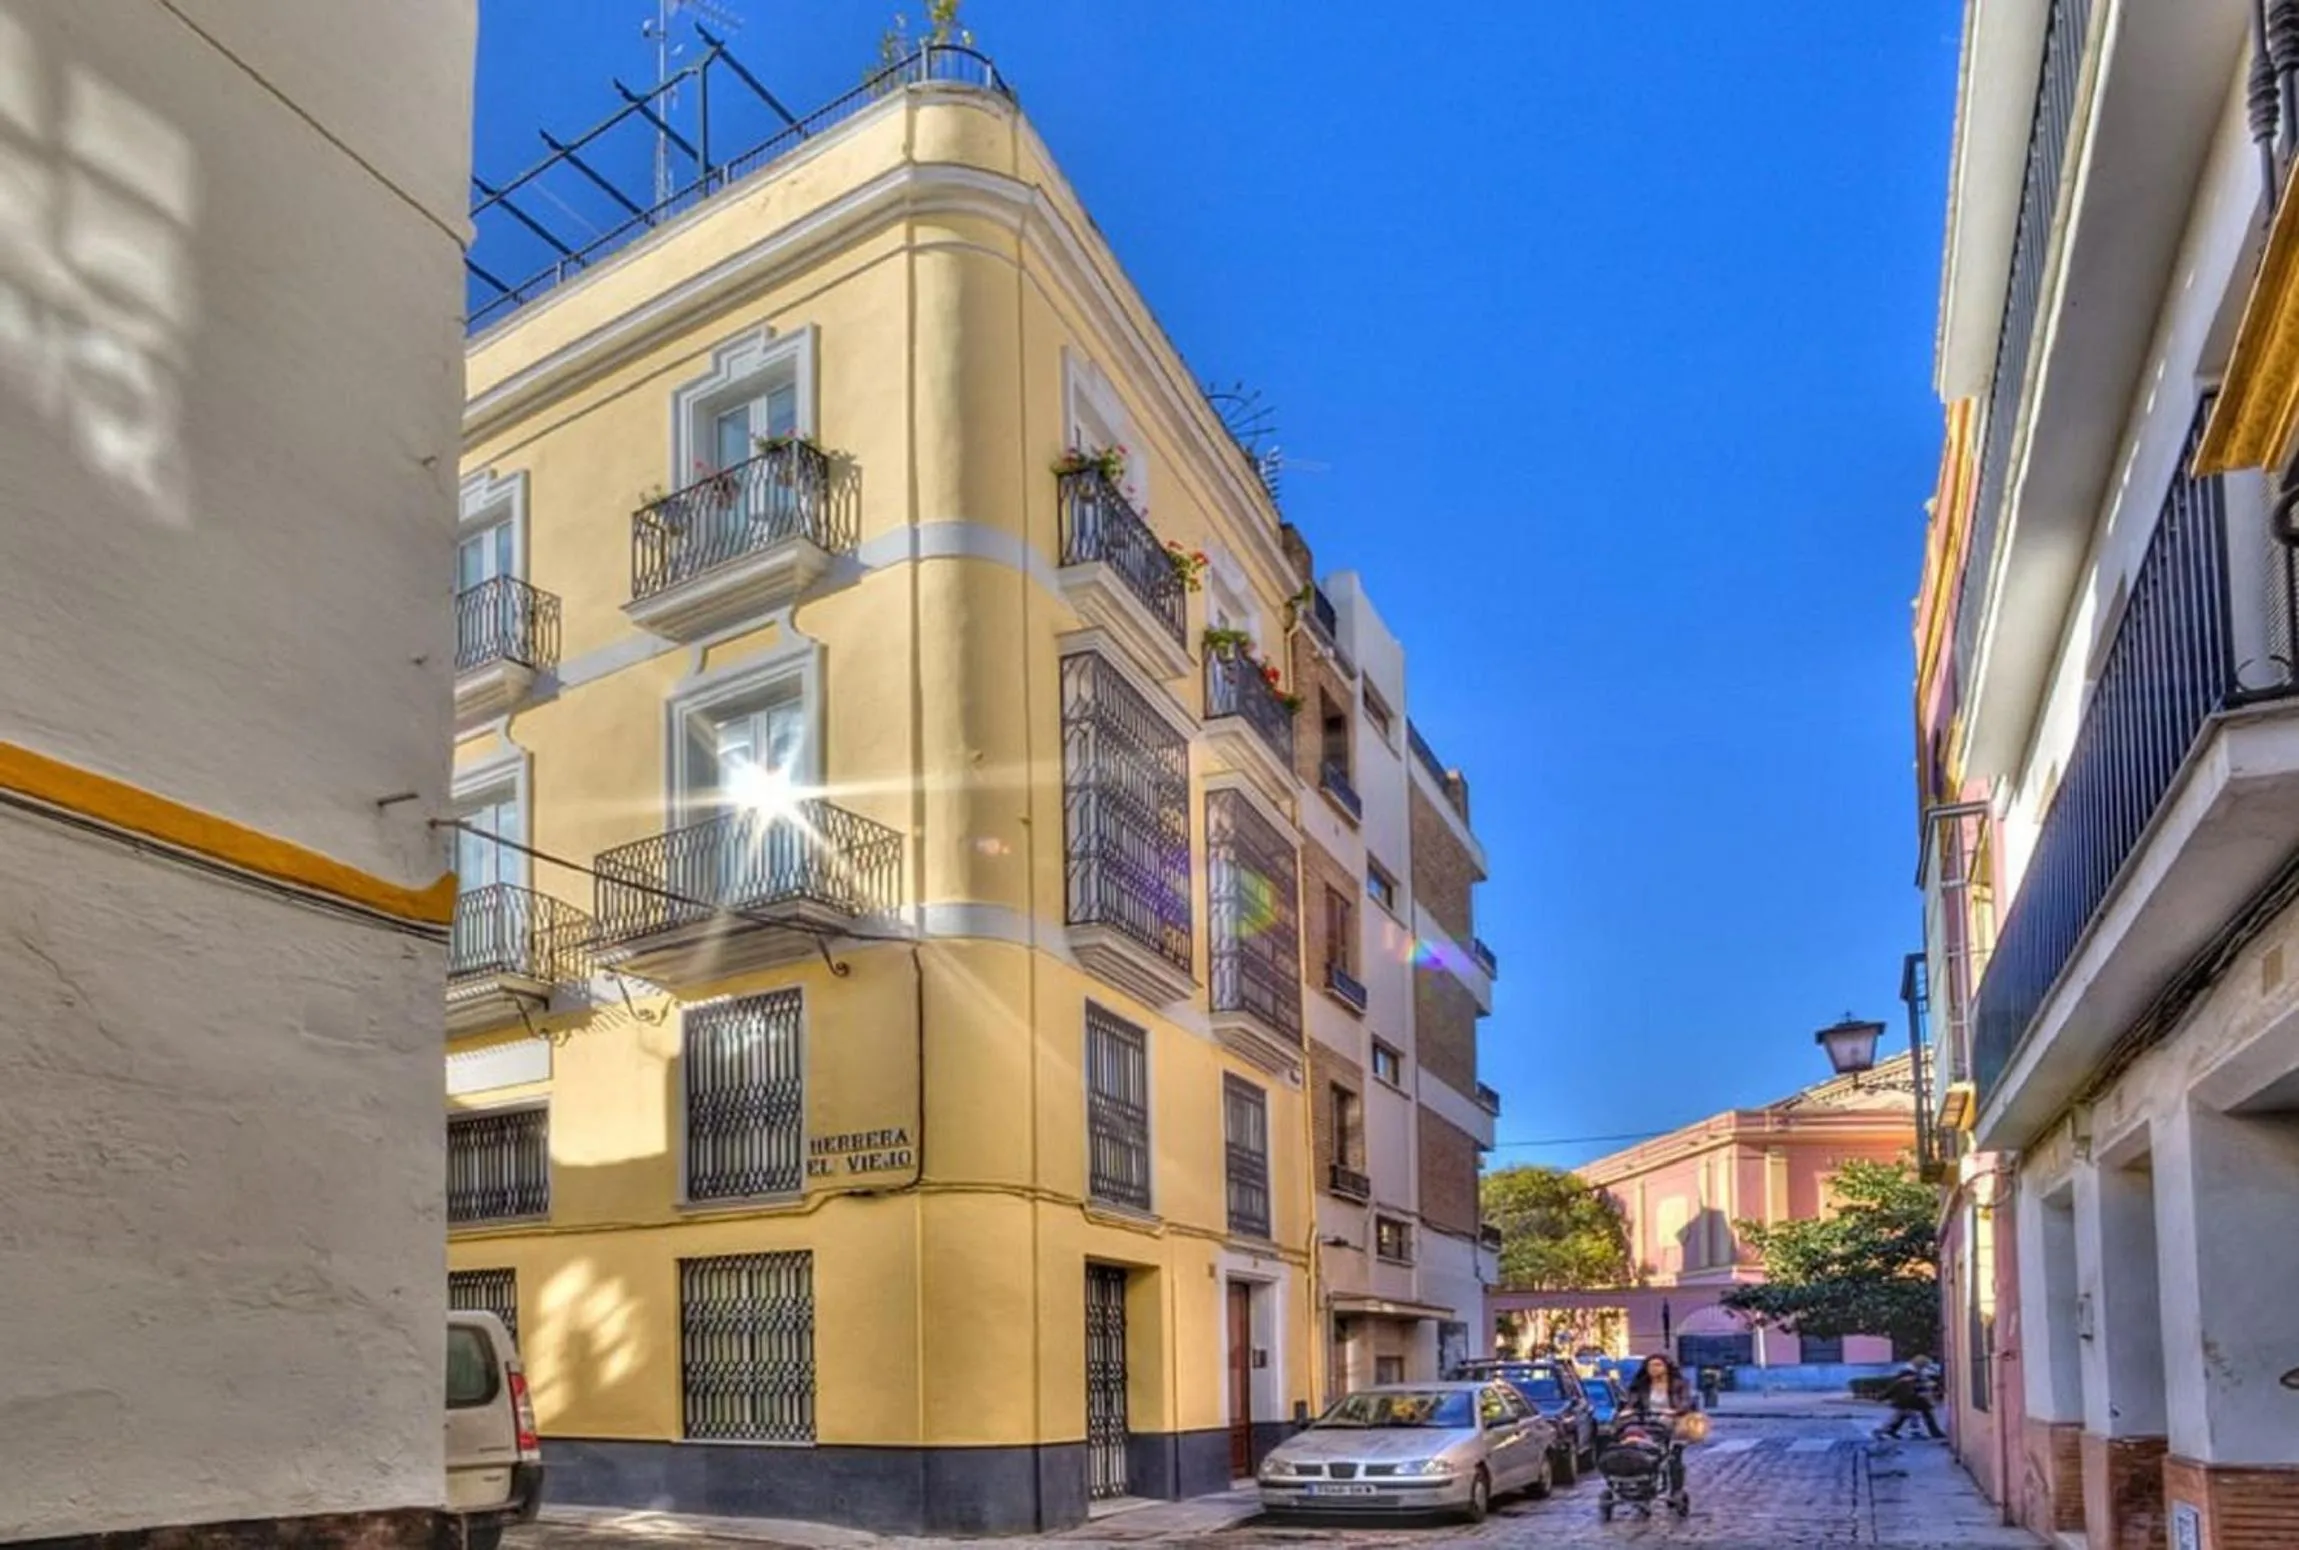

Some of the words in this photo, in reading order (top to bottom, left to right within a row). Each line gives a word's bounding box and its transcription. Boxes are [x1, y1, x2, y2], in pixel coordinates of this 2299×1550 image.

[810, 1128, 909, 1154] HERRERA
[806, 1158, 832, 1177] EL
[847, 1150, 912, 1173] VIEJO
